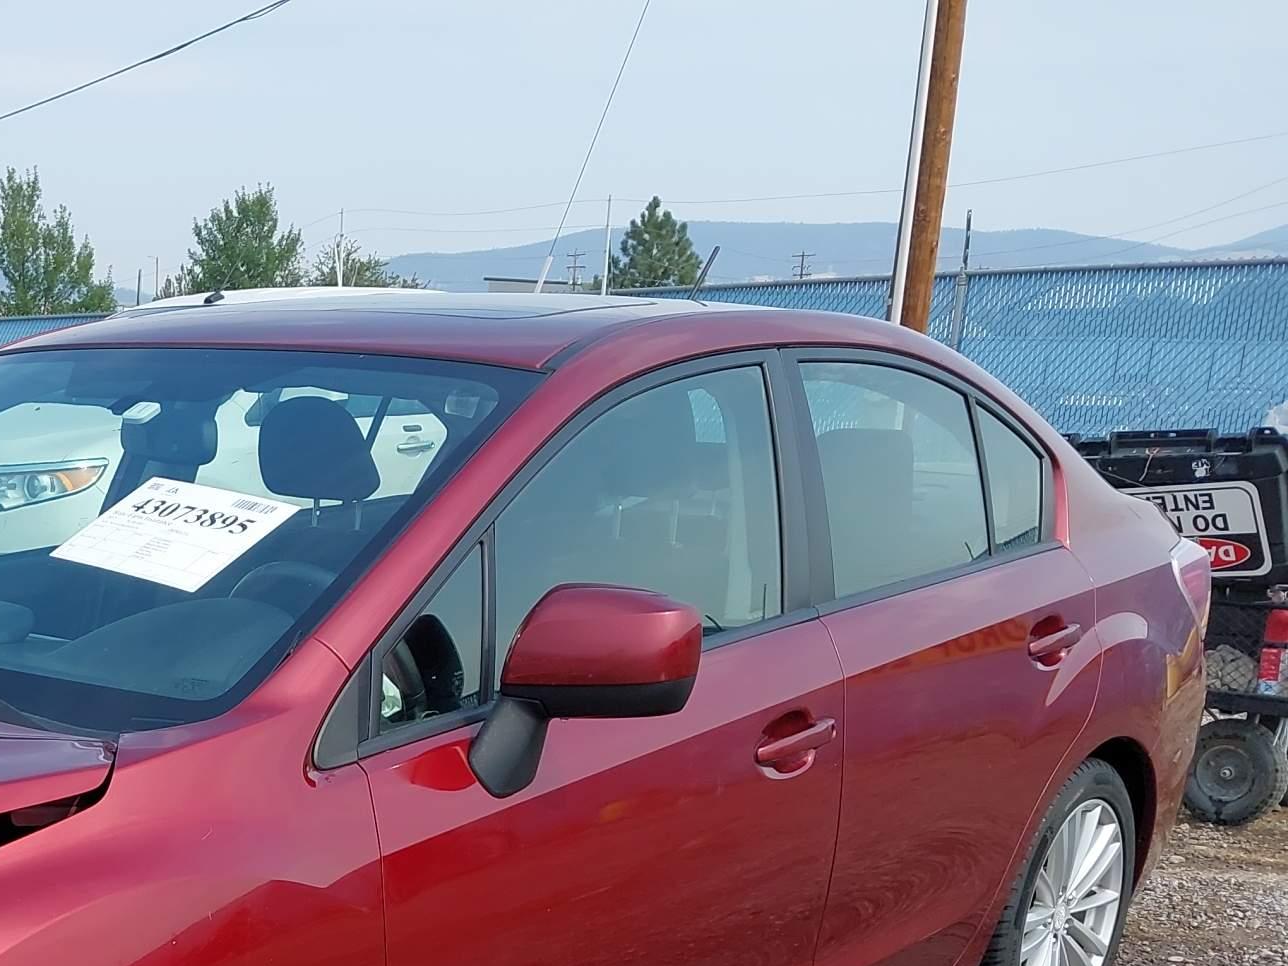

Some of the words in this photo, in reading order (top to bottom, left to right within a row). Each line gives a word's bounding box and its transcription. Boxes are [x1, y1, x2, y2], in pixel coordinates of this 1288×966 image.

[1146, 493, 1215, 512] ENTE
[131, 498, 257, 535] 43073895
[1193, 513, 1230, 532] DO
